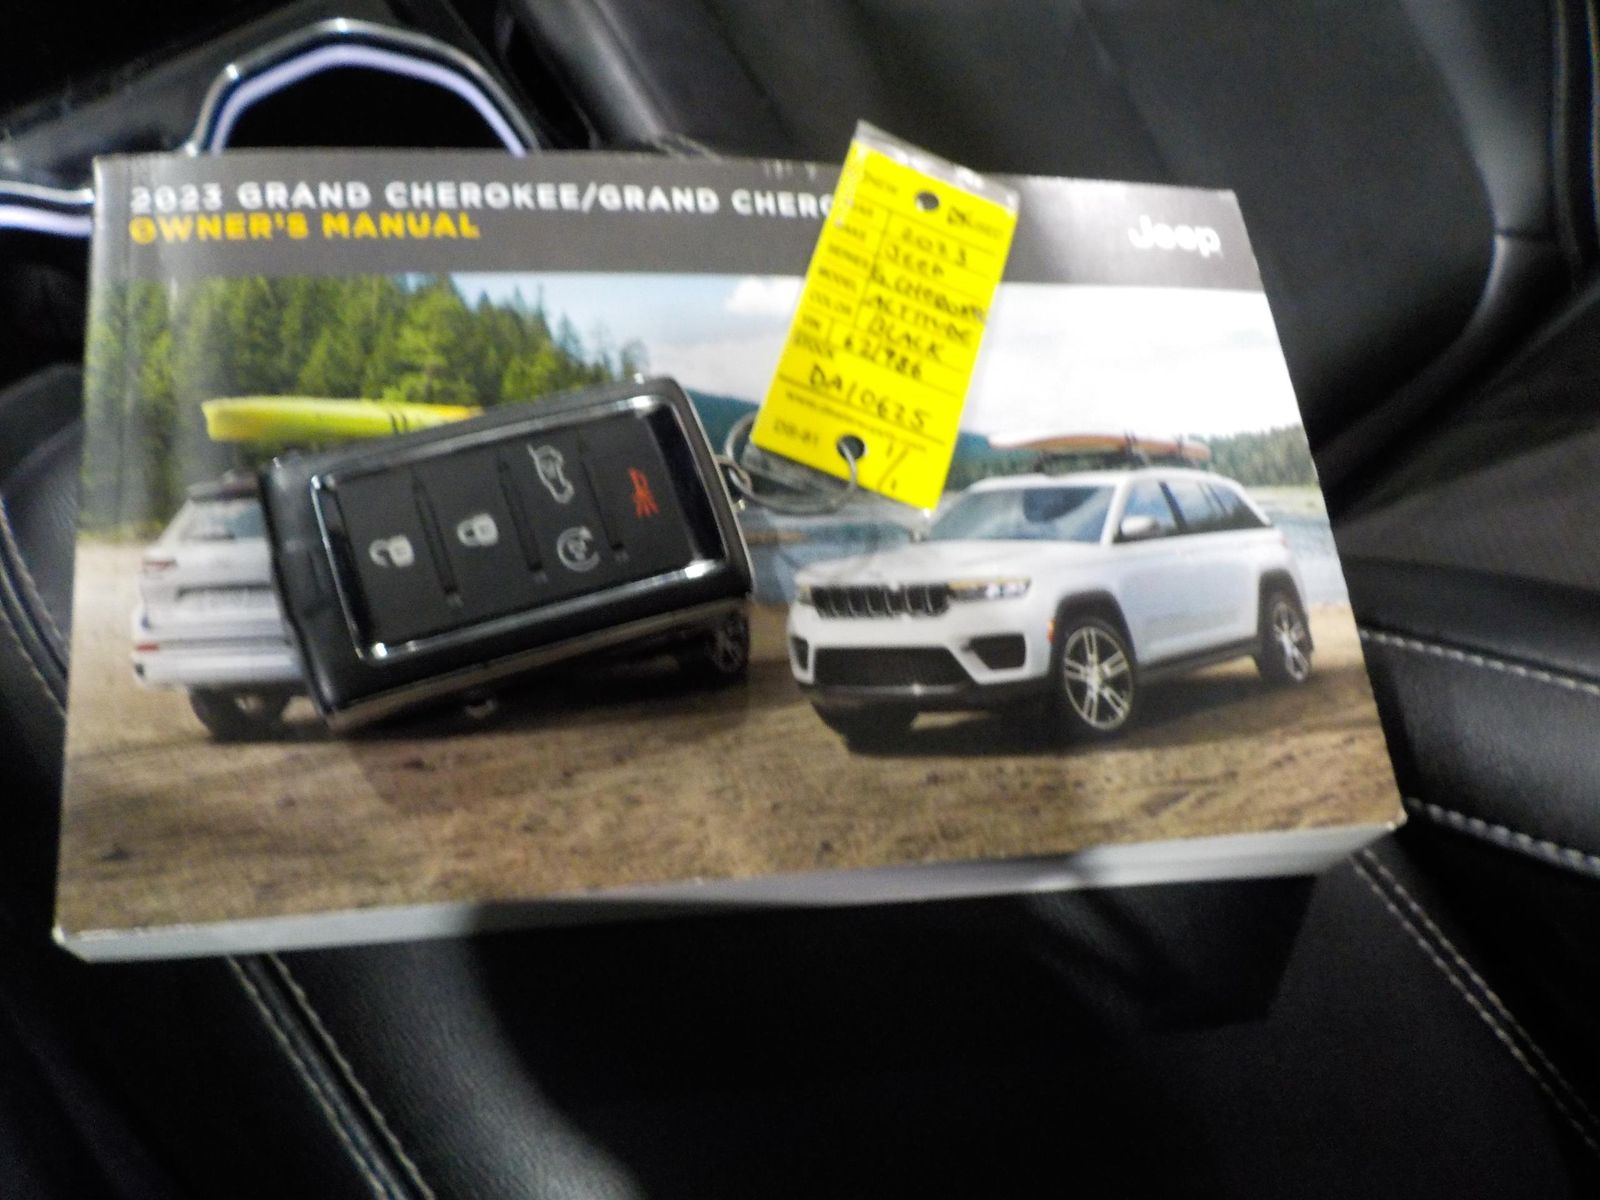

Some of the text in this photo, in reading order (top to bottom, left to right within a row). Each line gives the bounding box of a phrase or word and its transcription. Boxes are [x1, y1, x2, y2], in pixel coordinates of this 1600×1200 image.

[130, 183, 223, 213] 2023
[237, 181, 372, 210] GRAND
[385, 181, 720, 214] CHEROKEE/GRAND
[129, 212, 480, 244] OWNER'S MANUAL
[1128, 214, 1222, 258] Jeep
